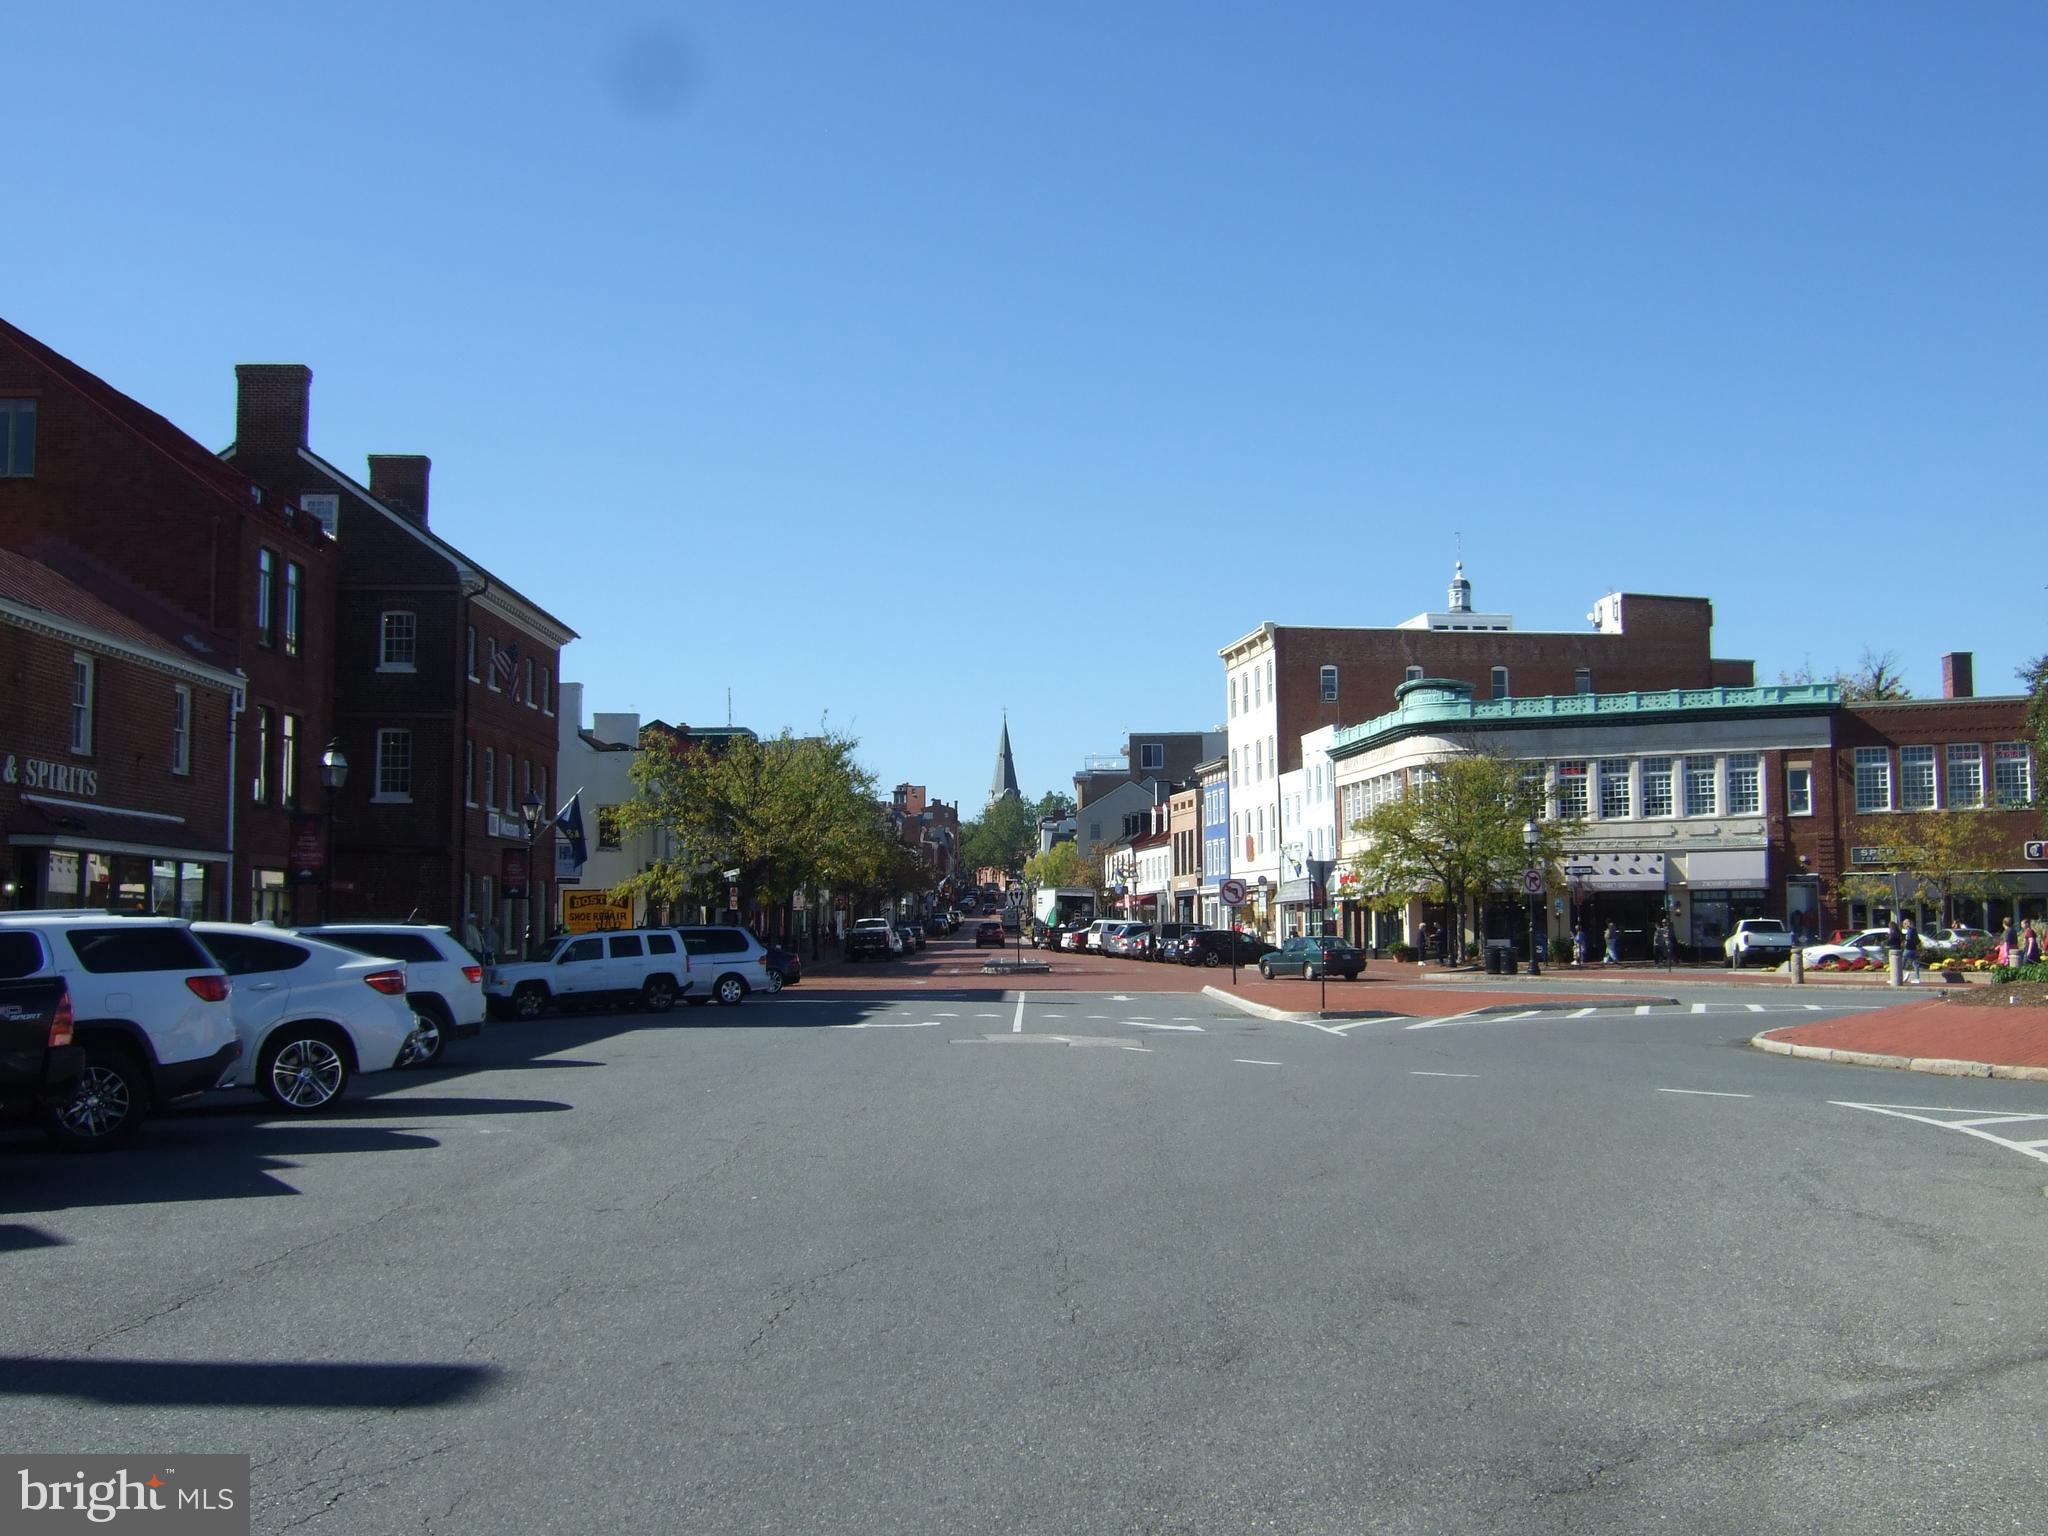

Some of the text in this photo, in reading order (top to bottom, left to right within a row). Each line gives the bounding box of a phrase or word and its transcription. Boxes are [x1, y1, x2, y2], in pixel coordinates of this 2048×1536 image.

[3, 755, 98, 797] & SPIRITS
[574, 895, 624, 907] BOSTN
[569, 912, 592, 921] SHOE
